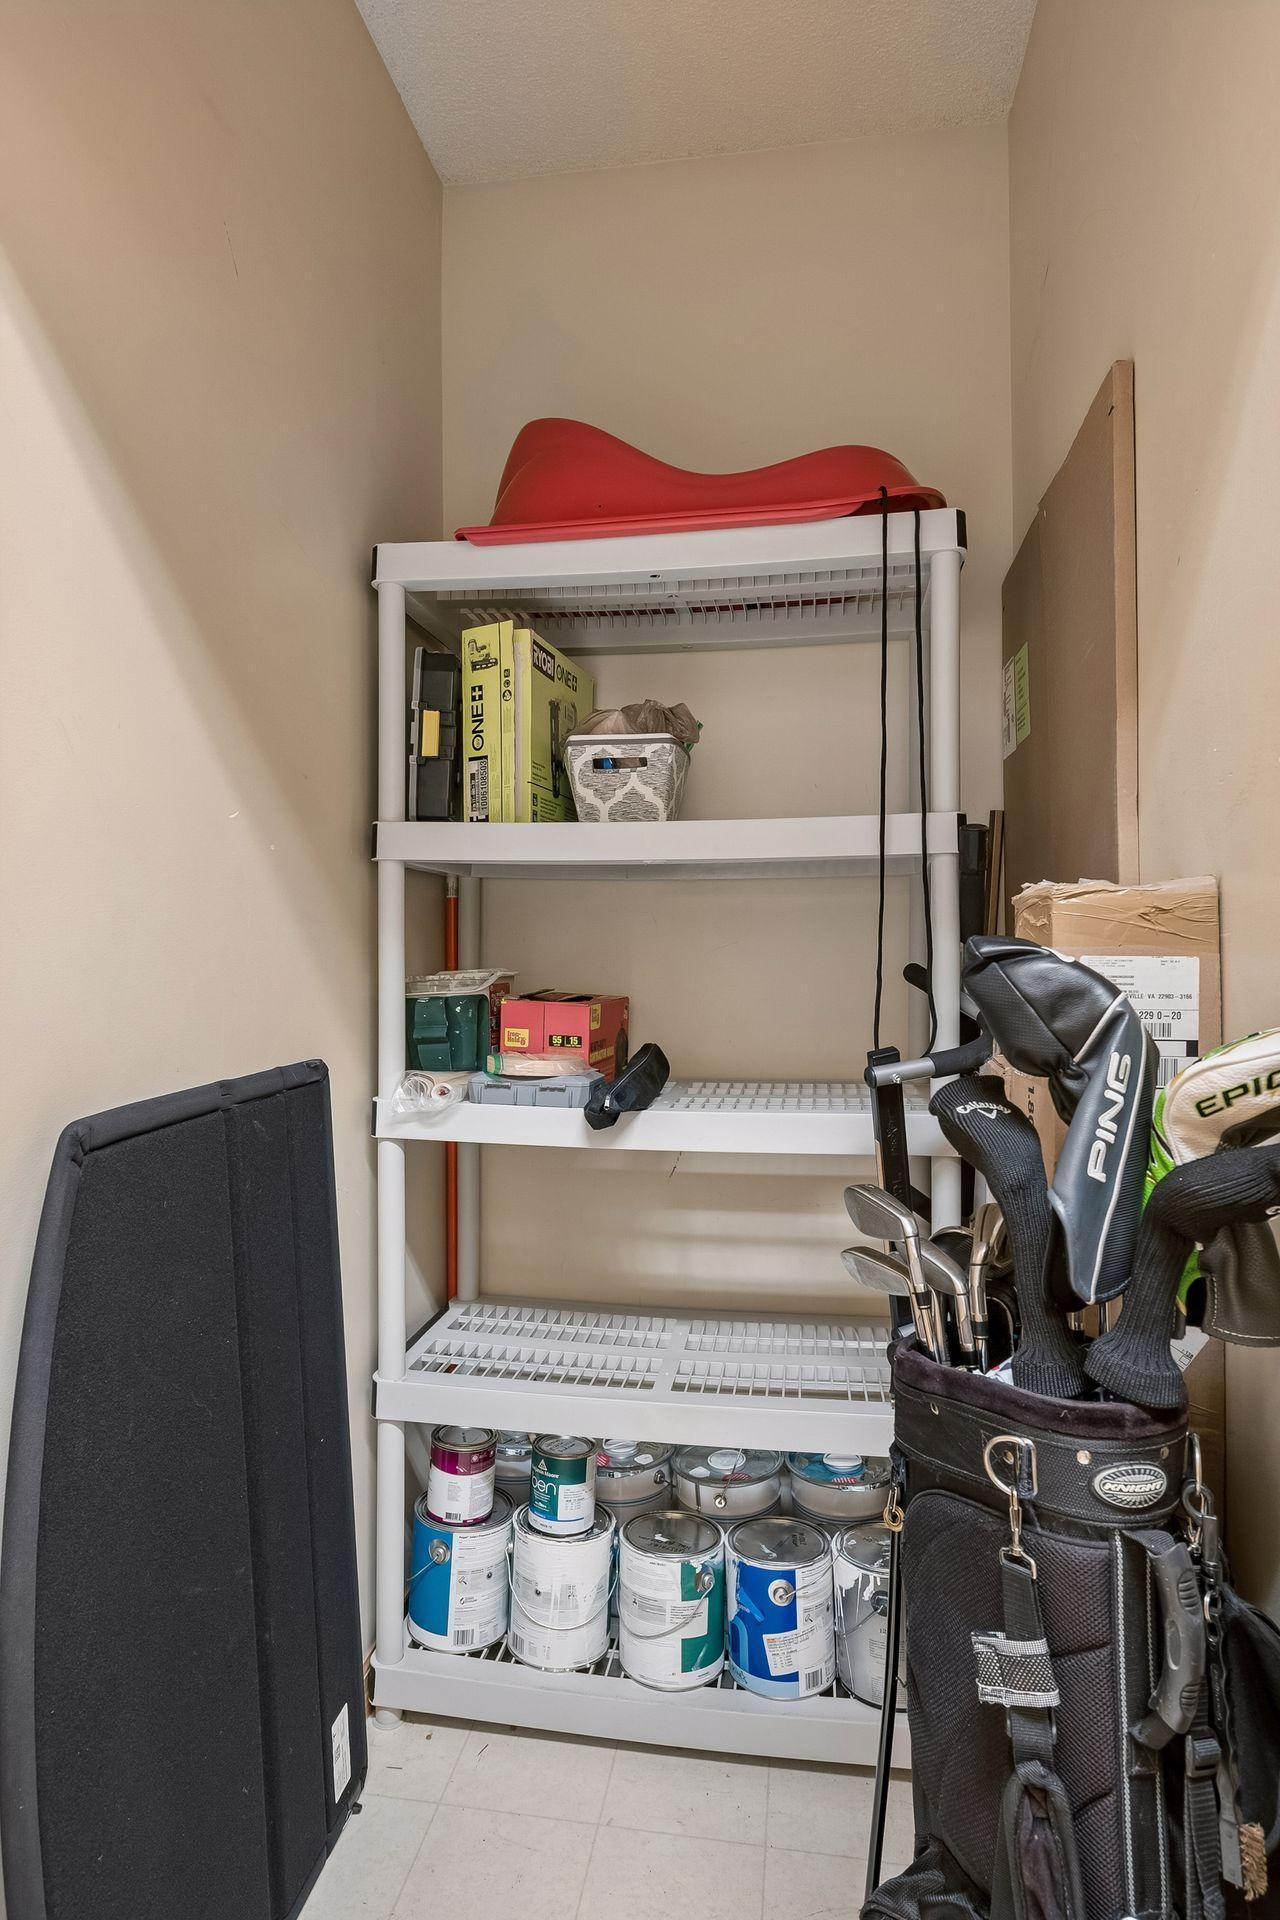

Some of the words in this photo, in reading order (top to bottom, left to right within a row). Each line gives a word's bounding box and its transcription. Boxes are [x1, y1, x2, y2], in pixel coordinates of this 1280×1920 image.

[532, 642, 555, 679] RYOBI
[1086, 1051, 1132, 1184] PING
[1103, 1481, 1164, 1493] KNIGHT
